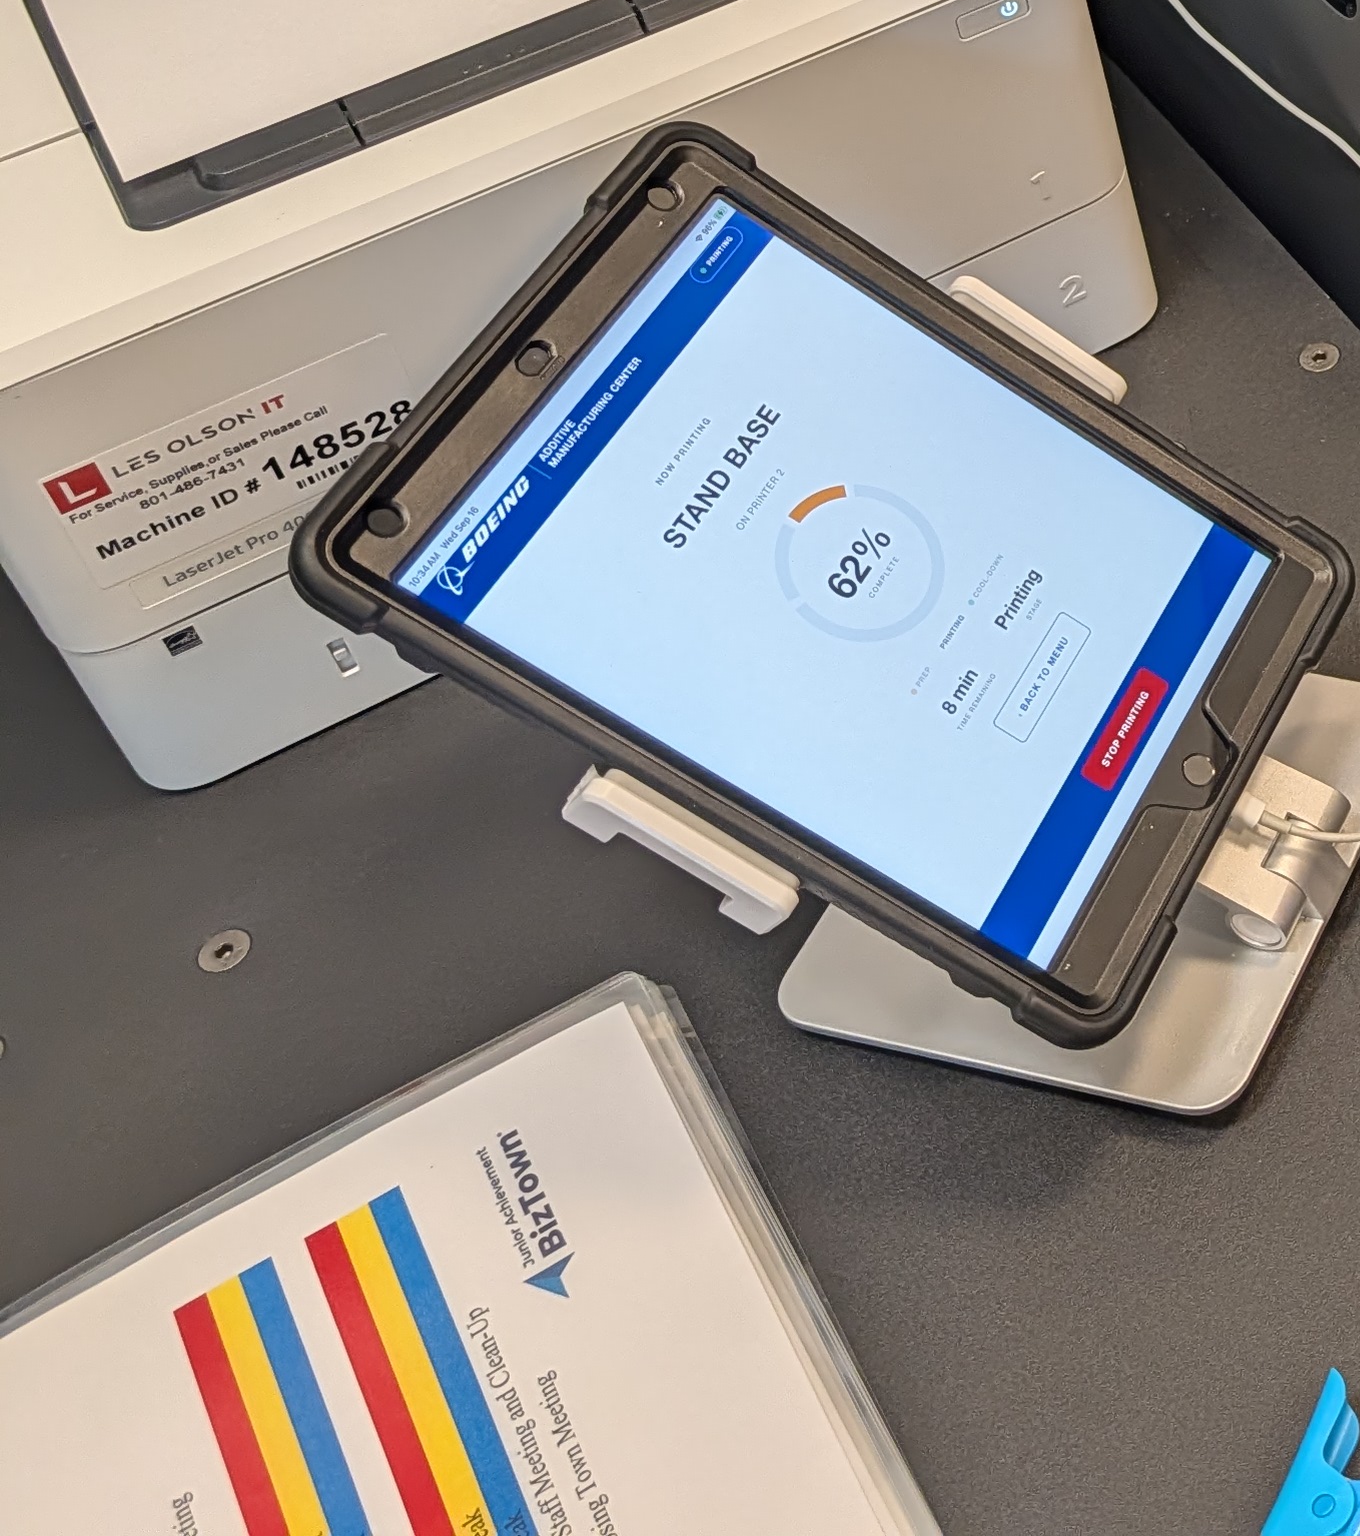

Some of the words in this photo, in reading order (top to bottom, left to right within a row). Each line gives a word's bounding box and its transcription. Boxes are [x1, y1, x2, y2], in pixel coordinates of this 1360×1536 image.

[701, 219, 717, 235] 96%
[705, 236, 734, 267] PRINTING
[1059, 275, 1087, 307] 2
[110, 449, 160, 479] LES
[167, 407, 256, 454] OLSON
[260, 394, 285, 415] IT
[538, 418, 577, 462] ADDITIVE
[547, 392, 613, 468] MANUFACTURING
[609, 356, 643, 393] CENTER
[69, 510, 92, 525] For
[94, 486, 148, 513] Service,
[223, 438, 259, 458] Sales
[260, 419, 302, 442] Please
[304, 405, 328, 423] Call
[96, 504, 206, 560] Machine
[210, 487, 240, 510] ID
[243, 477, 262, 494] #
[262, 399, 413, 481] 148528
[655, 462, 676, 486] NOW
[673, 417, 711, 462] PRINTING
[663, 469, 731, 549] STAND
[722, 403, 781, 469] BASE
[139, 457, 246, 510] 801-486-7431
[735, 514, 750, 531] ON
[747, 475, 779, 516] PRINTER
[776, 468, 785, 477] 2
[408, 565, 430, 587] 10:34
[424, 551, 441, 569] AM
[440, 530, 459, 550] Wed
[455, 516, 471, 538] Sep
[467, 506, 480, 520] 16
[461, 475, 530, 563] BOEING
[162, 544, 244, 588] LaserJet
[245, 528, 279, 550] Pro
[827, 527, 891, 598] 62%
[868, 556, 900, 599] COMPLETE
[972, 554, 1004, 599] COOL-DOWN
[994, 569, 1043, 631] Printing
[1026, 598, 1043, 621] STAGE
[939, 614, 966, 650] PRINTING
[915, 666, 931, 688] PREP
[941, 700, 957, 715] 8
[952, 669, 979, 703] min
[957, 713, 972, 732] TIME
[968, 673, 997, 715] REMAINING
[1019, 683, 1042, 712] BACK
[1037, 668, 1051, 684] TO
[1047, 636, 1069, 667] MENU
[1101, 739, 1121, 768] STOP
[1117, 690, 1150, 740] PRINTING
[476, 1146, 518, 1226] Achievement
[511, 1228, 536, 1268] Junior
[466, 1306, 511, 1389] Clean-Up
[495, 1386, 525, 1421] and
[537, 1369, 576, 1448] Meeting
[515, 1418, 555, 1499] Meeting
[567, 1443, 597, 1500] Town
[537, 1494, 573, 1536] Staff
